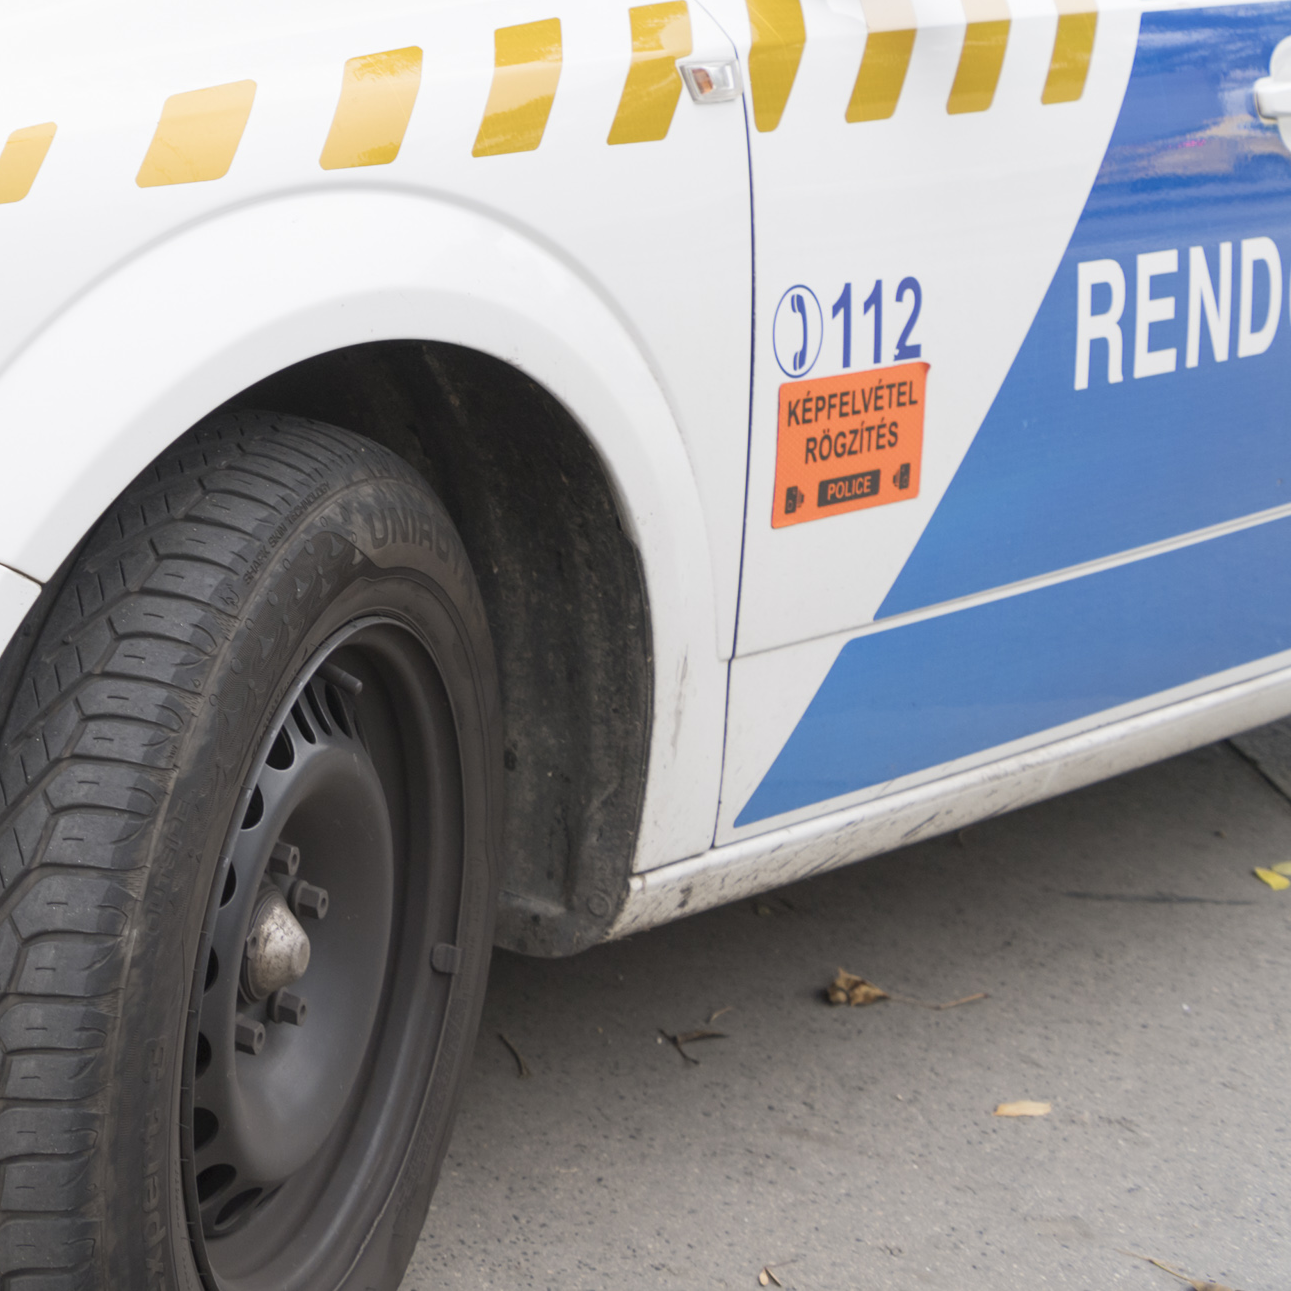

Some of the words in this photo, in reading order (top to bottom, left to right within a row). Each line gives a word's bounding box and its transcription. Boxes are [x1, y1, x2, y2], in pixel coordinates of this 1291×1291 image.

[831, 275, 923, 369] 112
[1073, 235, 1291, 392] REND
[786, 378, 918, 428] KÉPFELVÉTEL
[804, 416, 899, 465] RÖGZÍTÉS
[827, 475, 872, 501] POLICE
[241, 543, 271, 586] SHARK
[267, 521, 288, 551] SKIN
[145, 796, 192, 936] OUTSIDE
